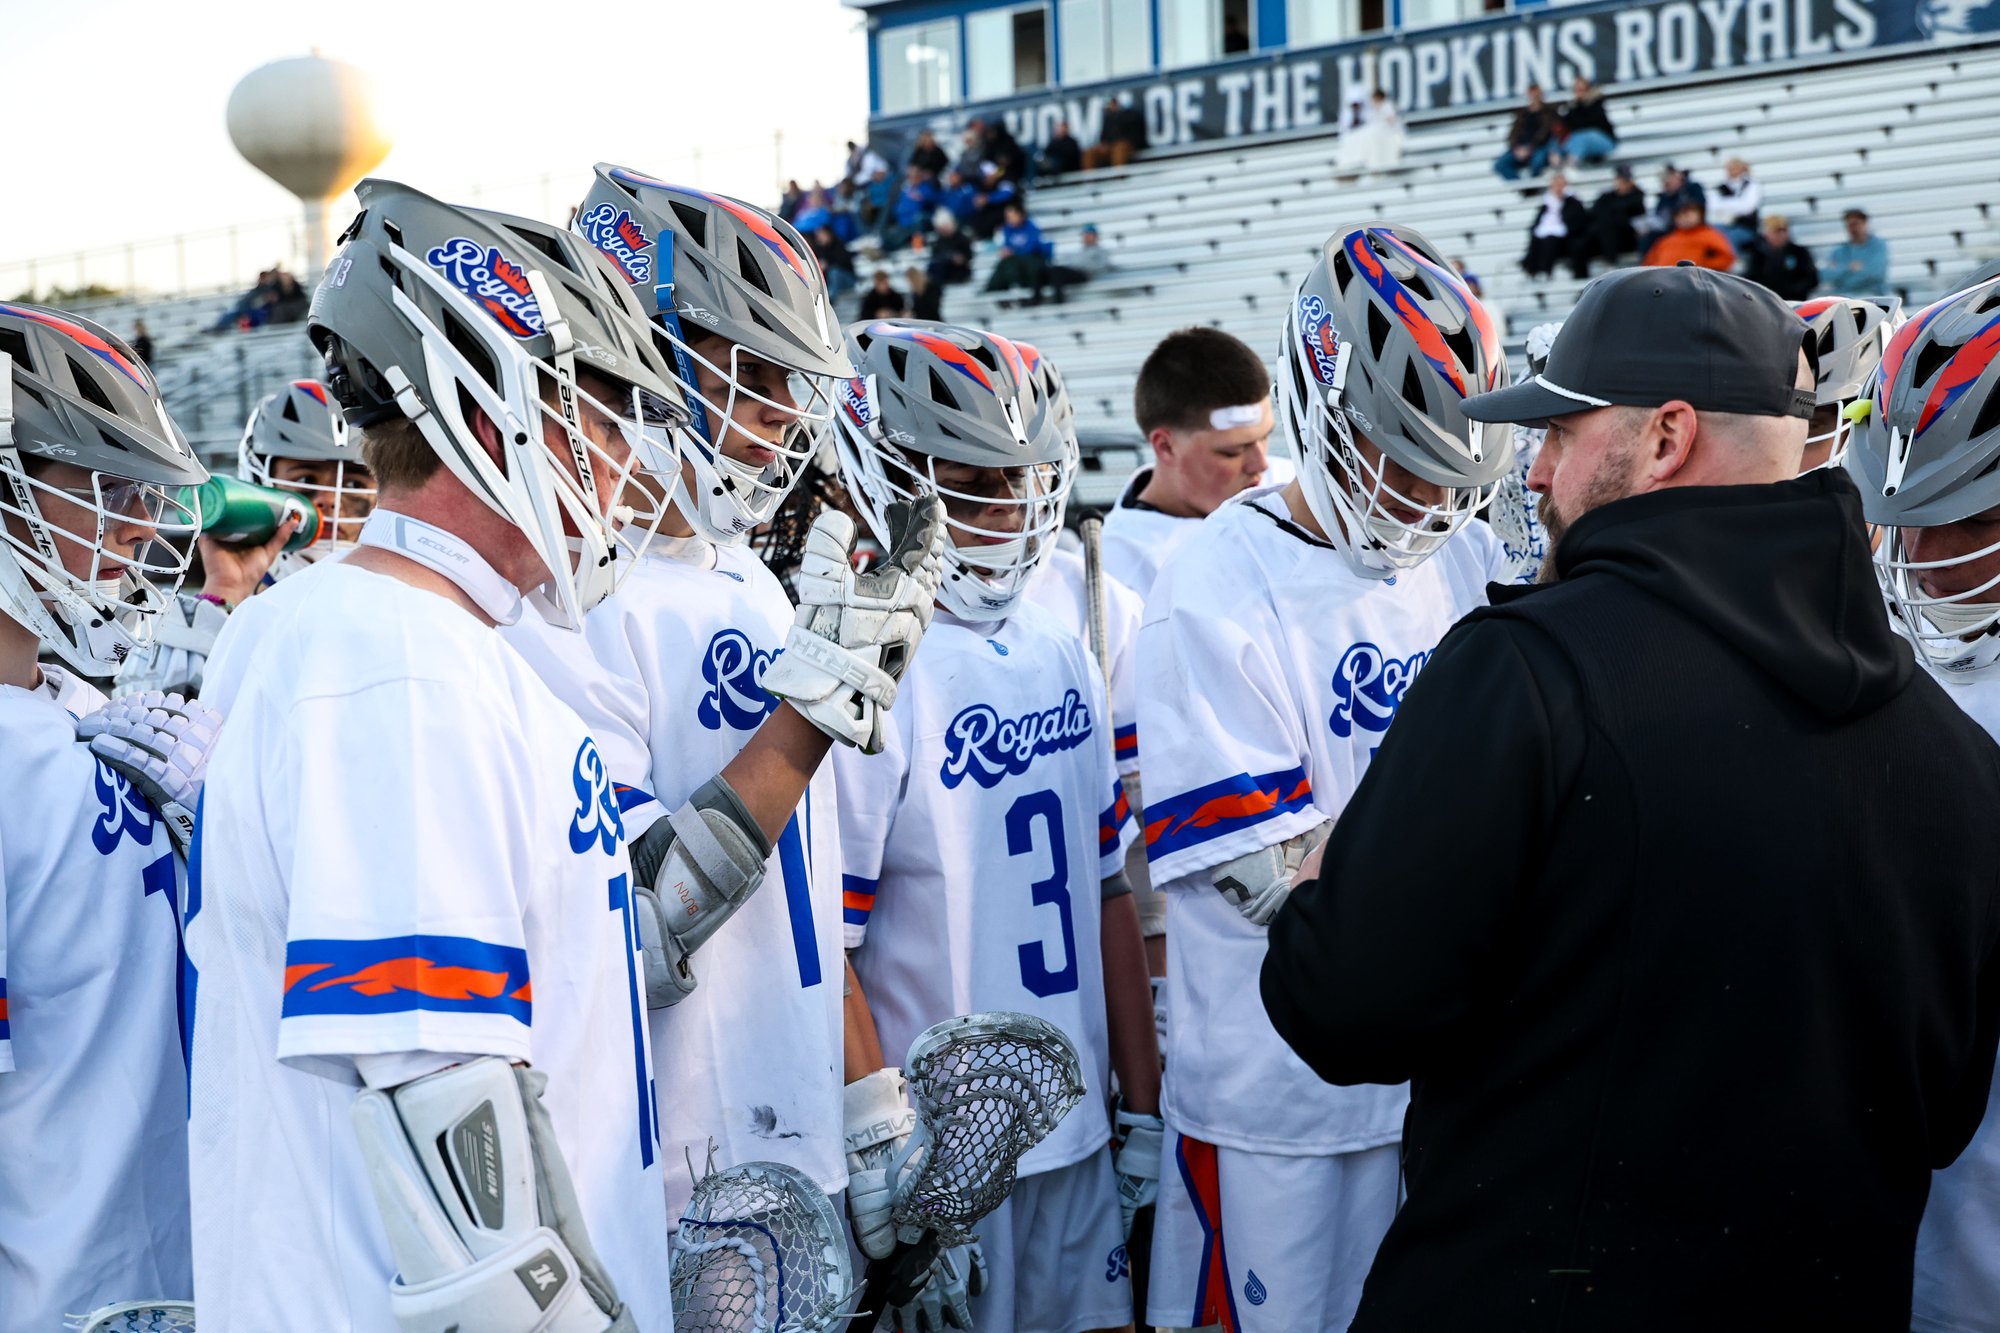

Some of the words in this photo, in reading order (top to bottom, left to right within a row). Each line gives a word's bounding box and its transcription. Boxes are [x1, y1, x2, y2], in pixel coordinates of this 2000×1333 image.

[1145, 81, 1204, 146] OF
[1217, 61, 1322, 137] THE
[1337, 20, 1596, 112] HOPKINS
[1613, 0, 1877, 82] ROYALS
[429, 239, 546, 334] Royals
[583, 203, 651, 284] Royals
[1300, 296, 1336, 386] Royals
[940, 689, 1093, 789] Royals
[1005, 788, 1079, 998] 3
